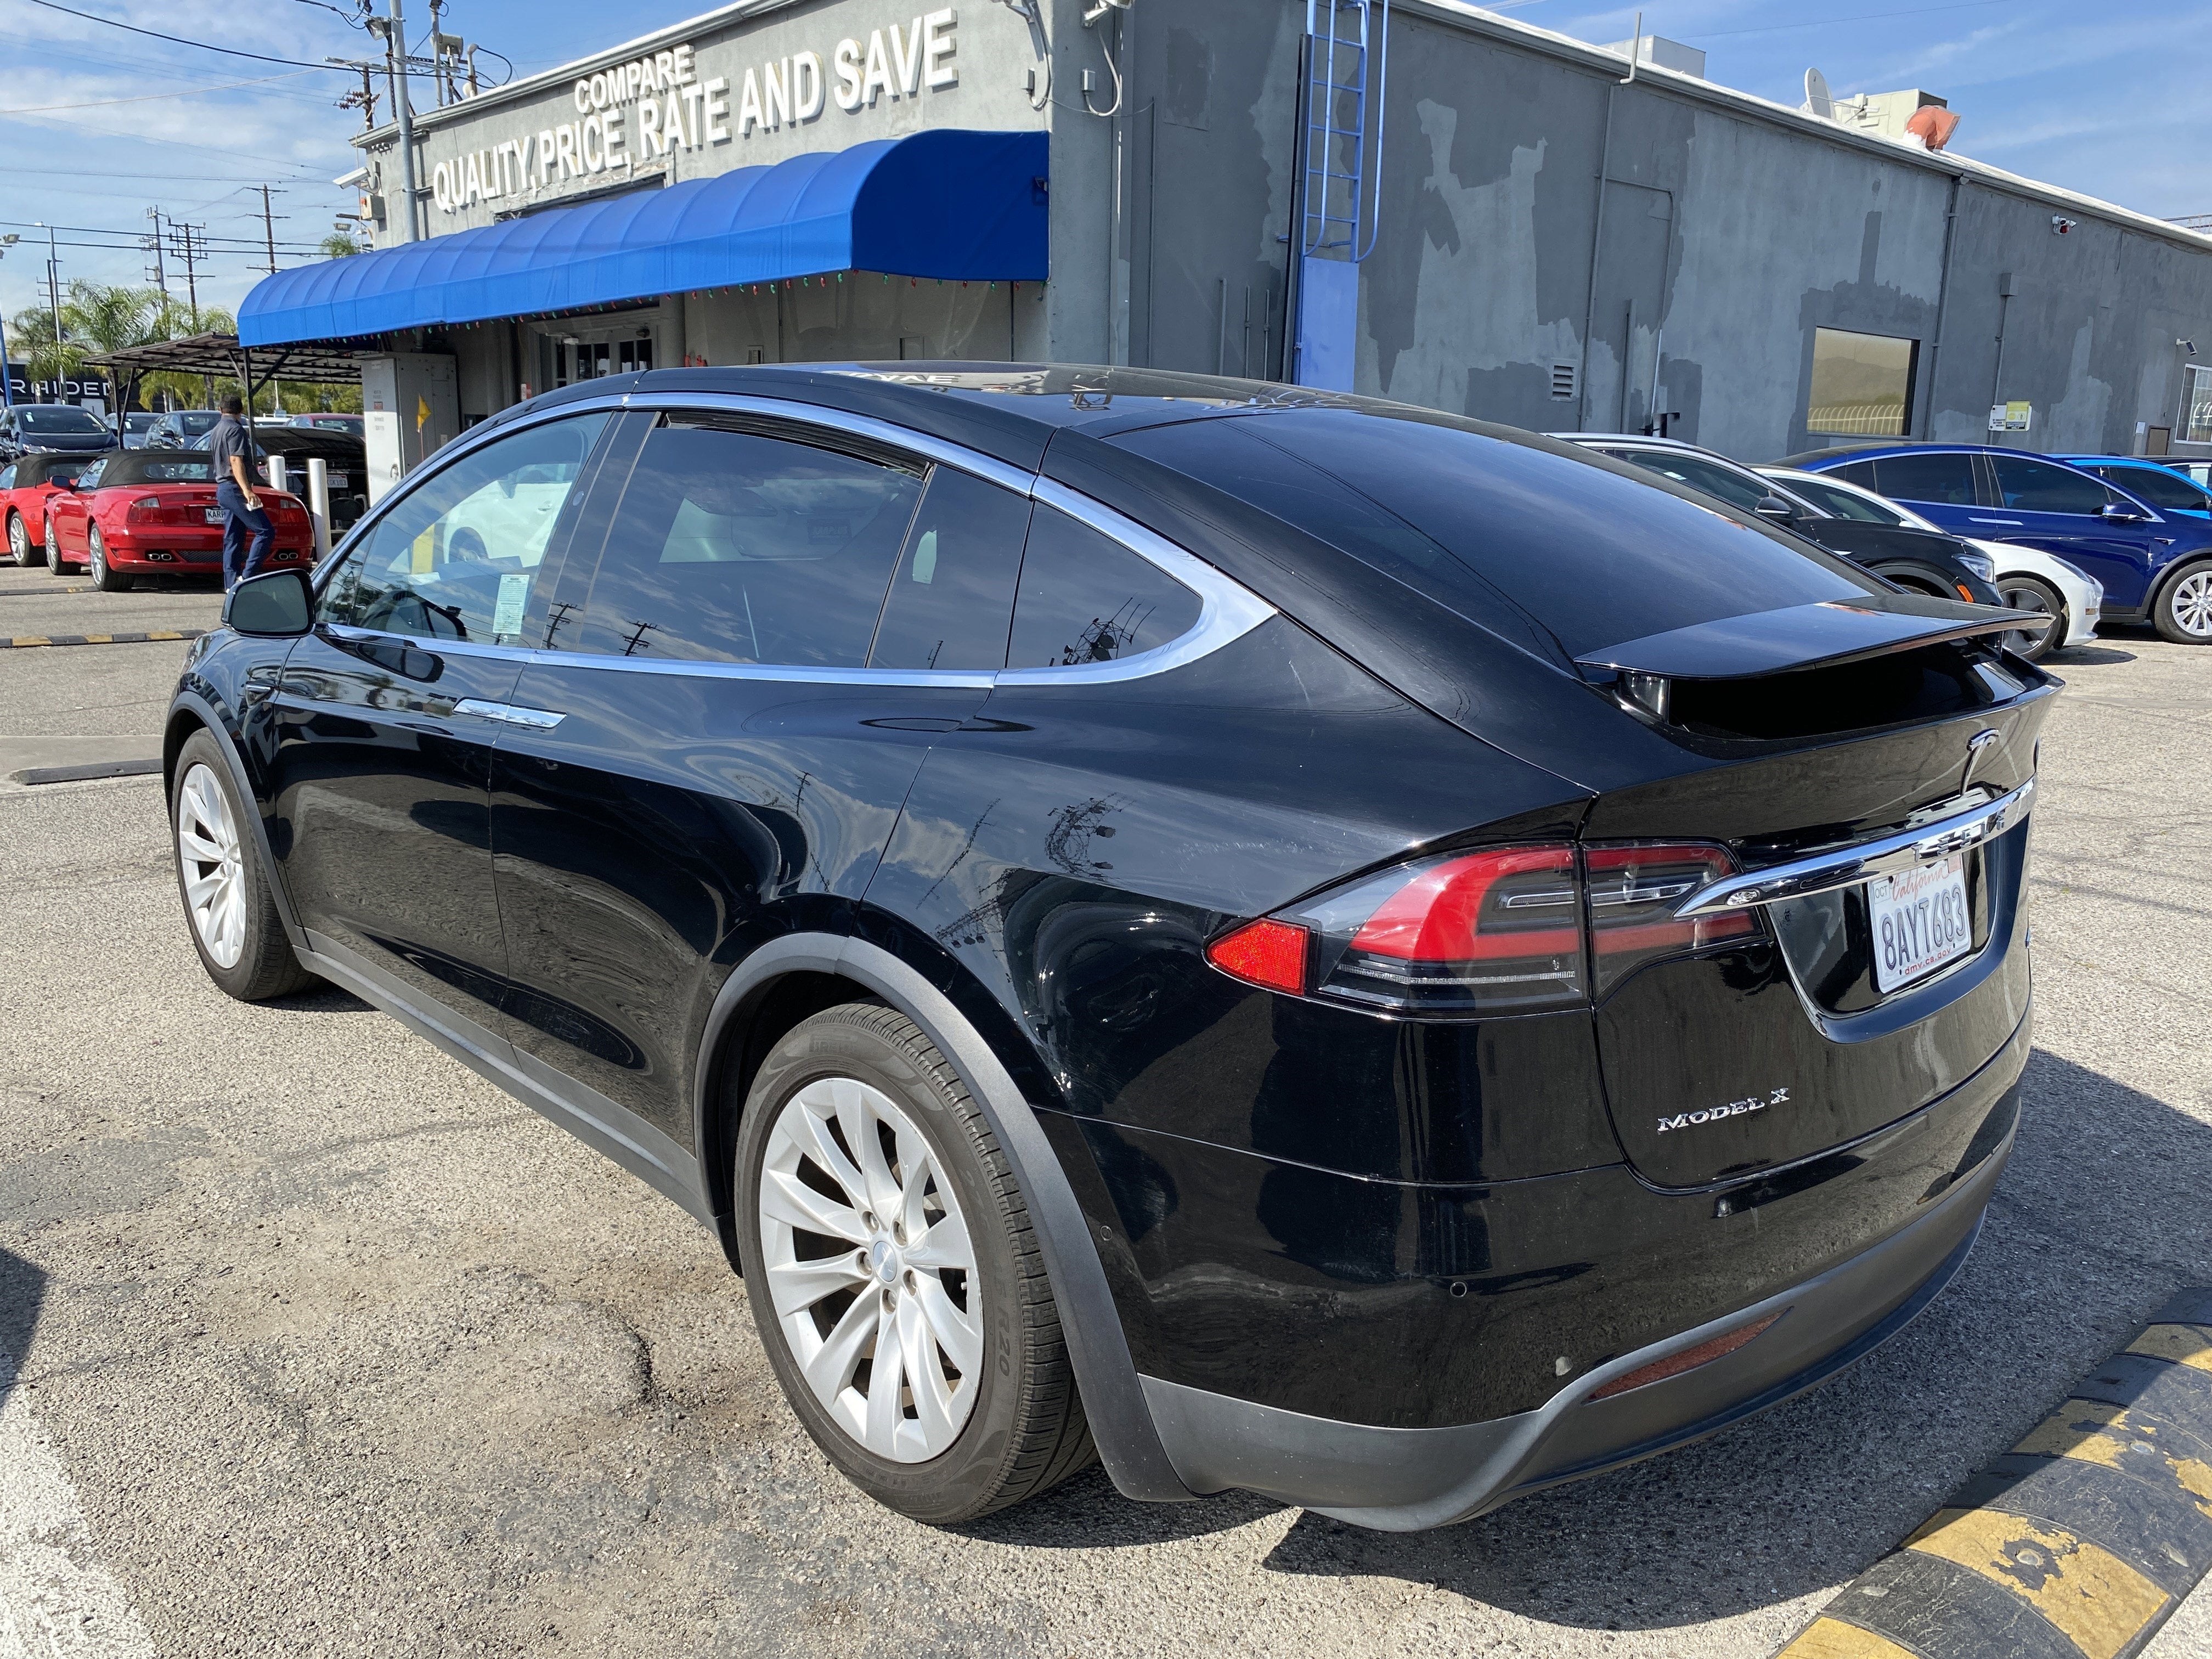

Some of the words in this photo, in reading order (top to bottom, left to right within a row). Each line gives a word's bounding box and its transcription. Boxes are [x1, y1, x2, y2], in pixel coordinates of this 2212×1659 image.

[574, 43, 696, 114] COMPARE
[433, 135, 538, 213] QUALITY,
[540, 109, 634, 184] PRICE,
[638, 76, 731, 159] RATE
[738, 50, 825, 134] AND
[834, 7, 958, 110] SAVE
[1875, 885, 1888, 899] OCT
[1893, 867, 1950, 901] California
[1881, 883, 1966, 970] 8AYT683
[1905, 947, 1951, 975] dmv.ca.gov
[1657, 1097, 1765, 1132] MODEL
[1770, 1087, 1790, 1104] X
